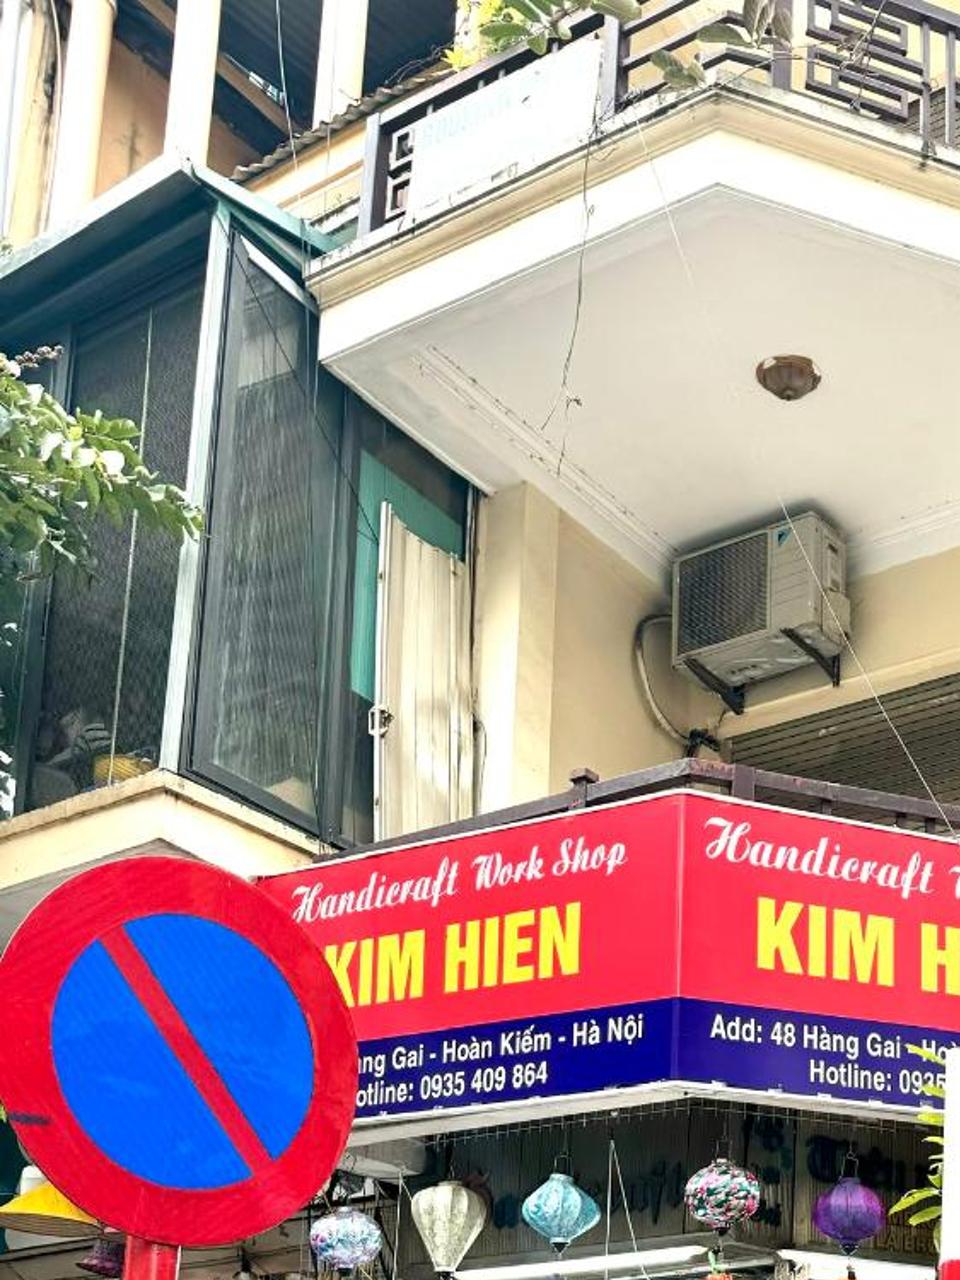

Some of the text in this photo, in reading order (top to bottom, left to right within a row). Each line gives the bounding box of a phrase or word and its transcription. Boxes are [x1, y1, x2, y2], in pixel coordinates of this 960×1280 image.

[291, 836, 628, 924] Handicraft Work Shop
[704, 816, 935, 900] Handicraft
[444, 902, 581, 994] HIEN
[757, 896, 895, 987] KIM
[392, 1042, 424, 1069] Gai
[442, 1035, 492, 1064] Hoàn
[500, 1027, 551, 1057] Kiếm
[573, 1019, 600, 1047] Hà
[608, 1013, 643, 1043] Nội
[710, 1014, 762, 1043] Add:
[771, 1022, 796, 1047] 48
[803, 1024, 859, 1058] Hàng
[867, 1034, 901, 1059] Gai
[356, 1061, 548, 1109] otline: 0935 409 864
[810, 1059, 892, 1092] Hotline:
